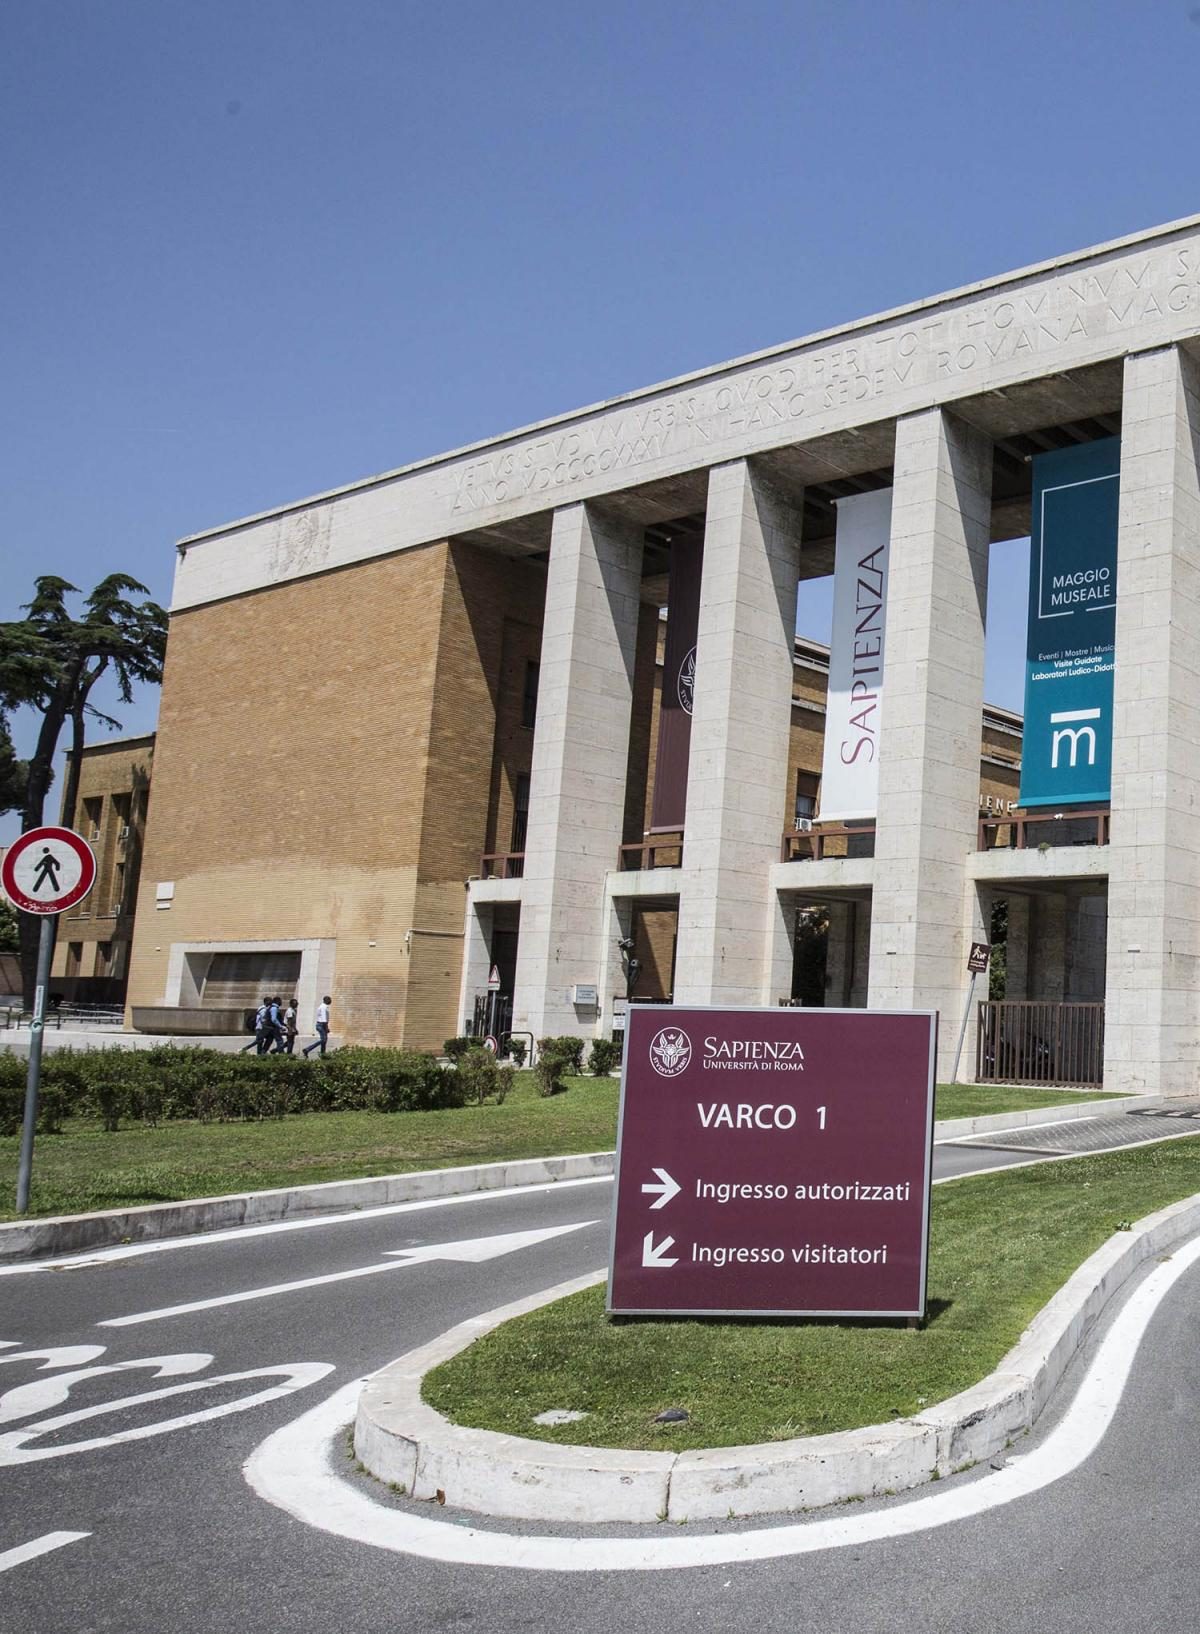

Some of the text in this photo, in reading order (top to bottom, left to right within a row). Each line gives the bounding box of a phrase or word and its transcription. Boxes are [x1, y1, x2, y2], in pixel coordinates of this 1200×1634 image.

[636, 397, 697, 432] VRBIS
[715, 368, 795, 411] QVOD
[812, 348, 861, 387] PER
[875, 322, 943, 366] TOT
[966, 261, 1152, 340] HOMINVM
[726, 393, 806, 434] HANC
[823, 362, 915, 409] SEDEM
[937, 313, 1090, 376] ROMANA
[1052, 567, 1110, 588] MAGGIO
[1051, 585, 1111, 606] MUSEALE
[1038, 651, 1060, 661] Eventi
[1064, 648, 1088, 658] Mostre
[1054, 656, 1102, 668] Visite Guidate
[1031, 669, 1068, 680] Laboratori
[703, 1036, 805, 1060] SAPIENZA
[761, 1062, 772, 1071] DI
[774, 1061, 804, 1072] ROMA
[697, 1103, 827, 1129] VARCO 1
[696, 1179, 910, 1203] Ingresso autorizzati
[692, 1243, 887, 1267] Ingresso visitatori
